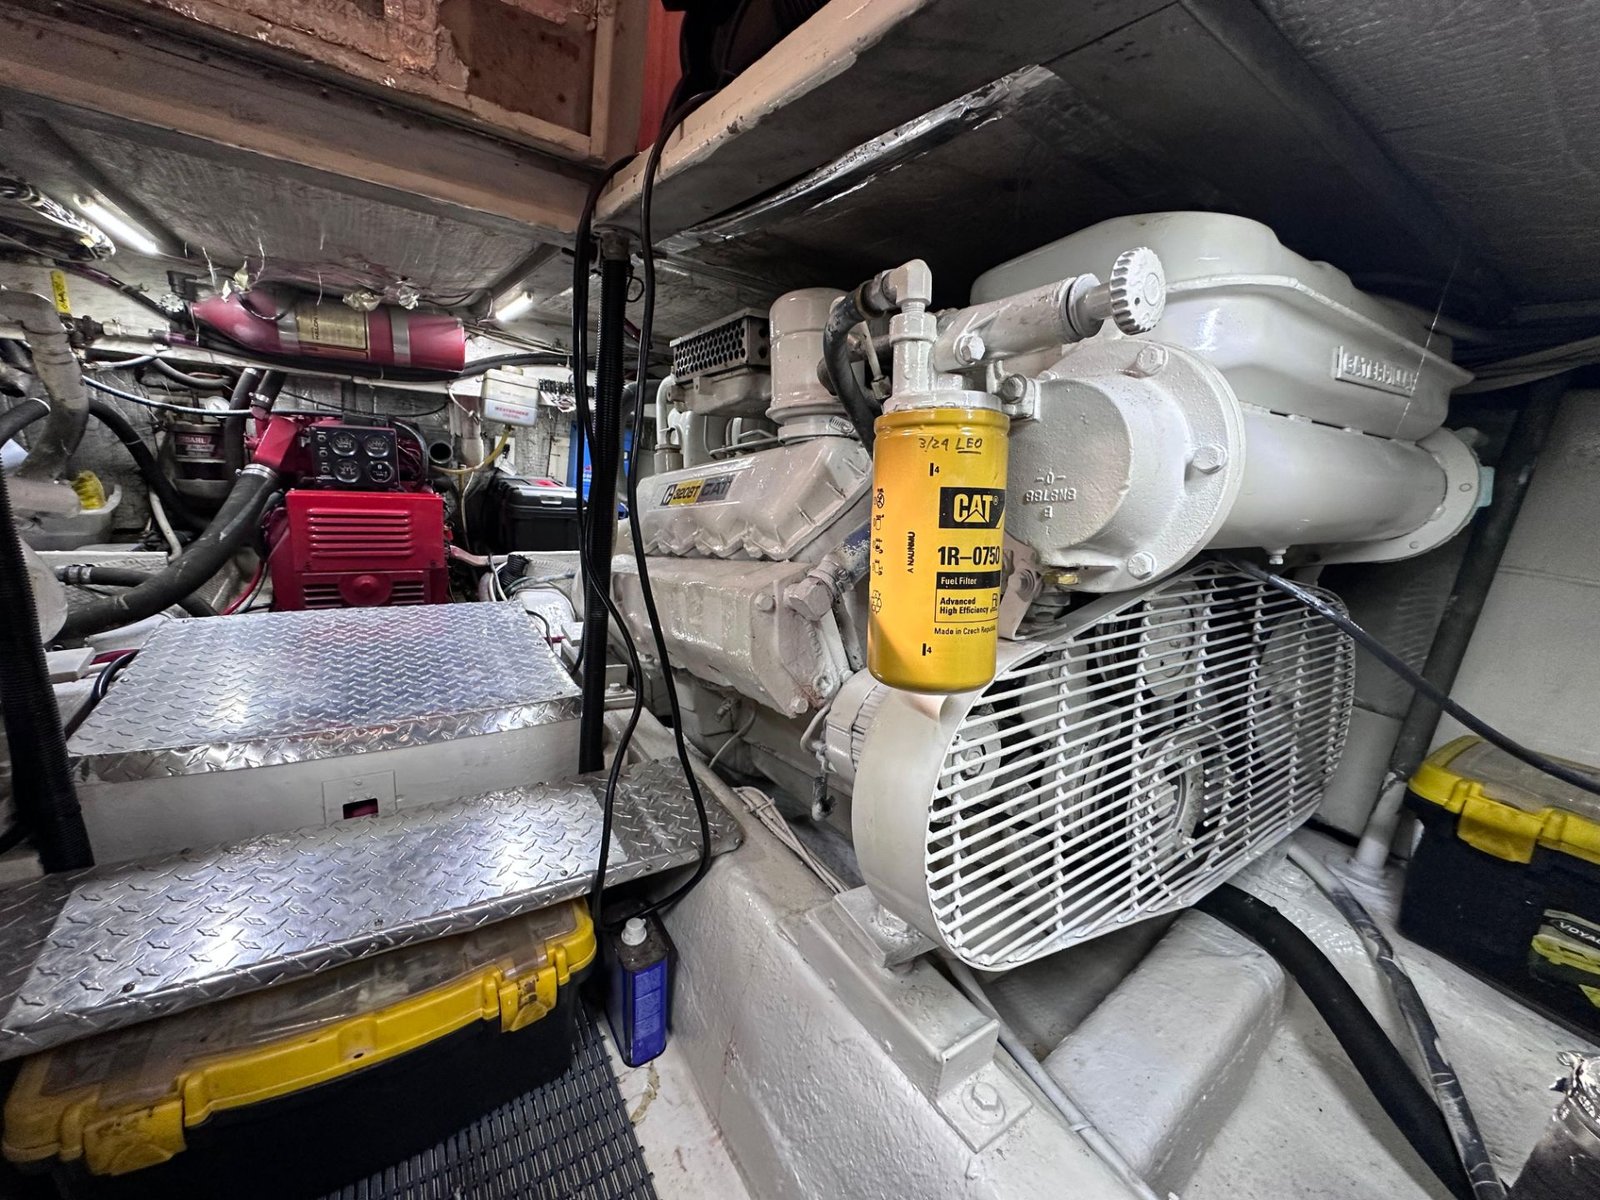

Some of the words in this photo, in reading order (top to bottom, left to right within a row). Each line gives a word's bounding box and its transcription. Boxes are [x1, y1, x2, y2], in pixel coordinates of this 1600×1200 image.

[955, 437, 983, 450] LEO
[953, 493, 993, 523] CAT
[937, 545, 1000, 566] 1R-0750
[941, 576, 958, 585] Fuel
[959, 576, 977, 585] Filter
[940, 597, 976, 605] Advanced
[940, 606, 957, 616] High
[959, 605, 989, 614] Efficiency
[935, 627, 953, 635] Made
[963, 627, 980, 635] Czech
